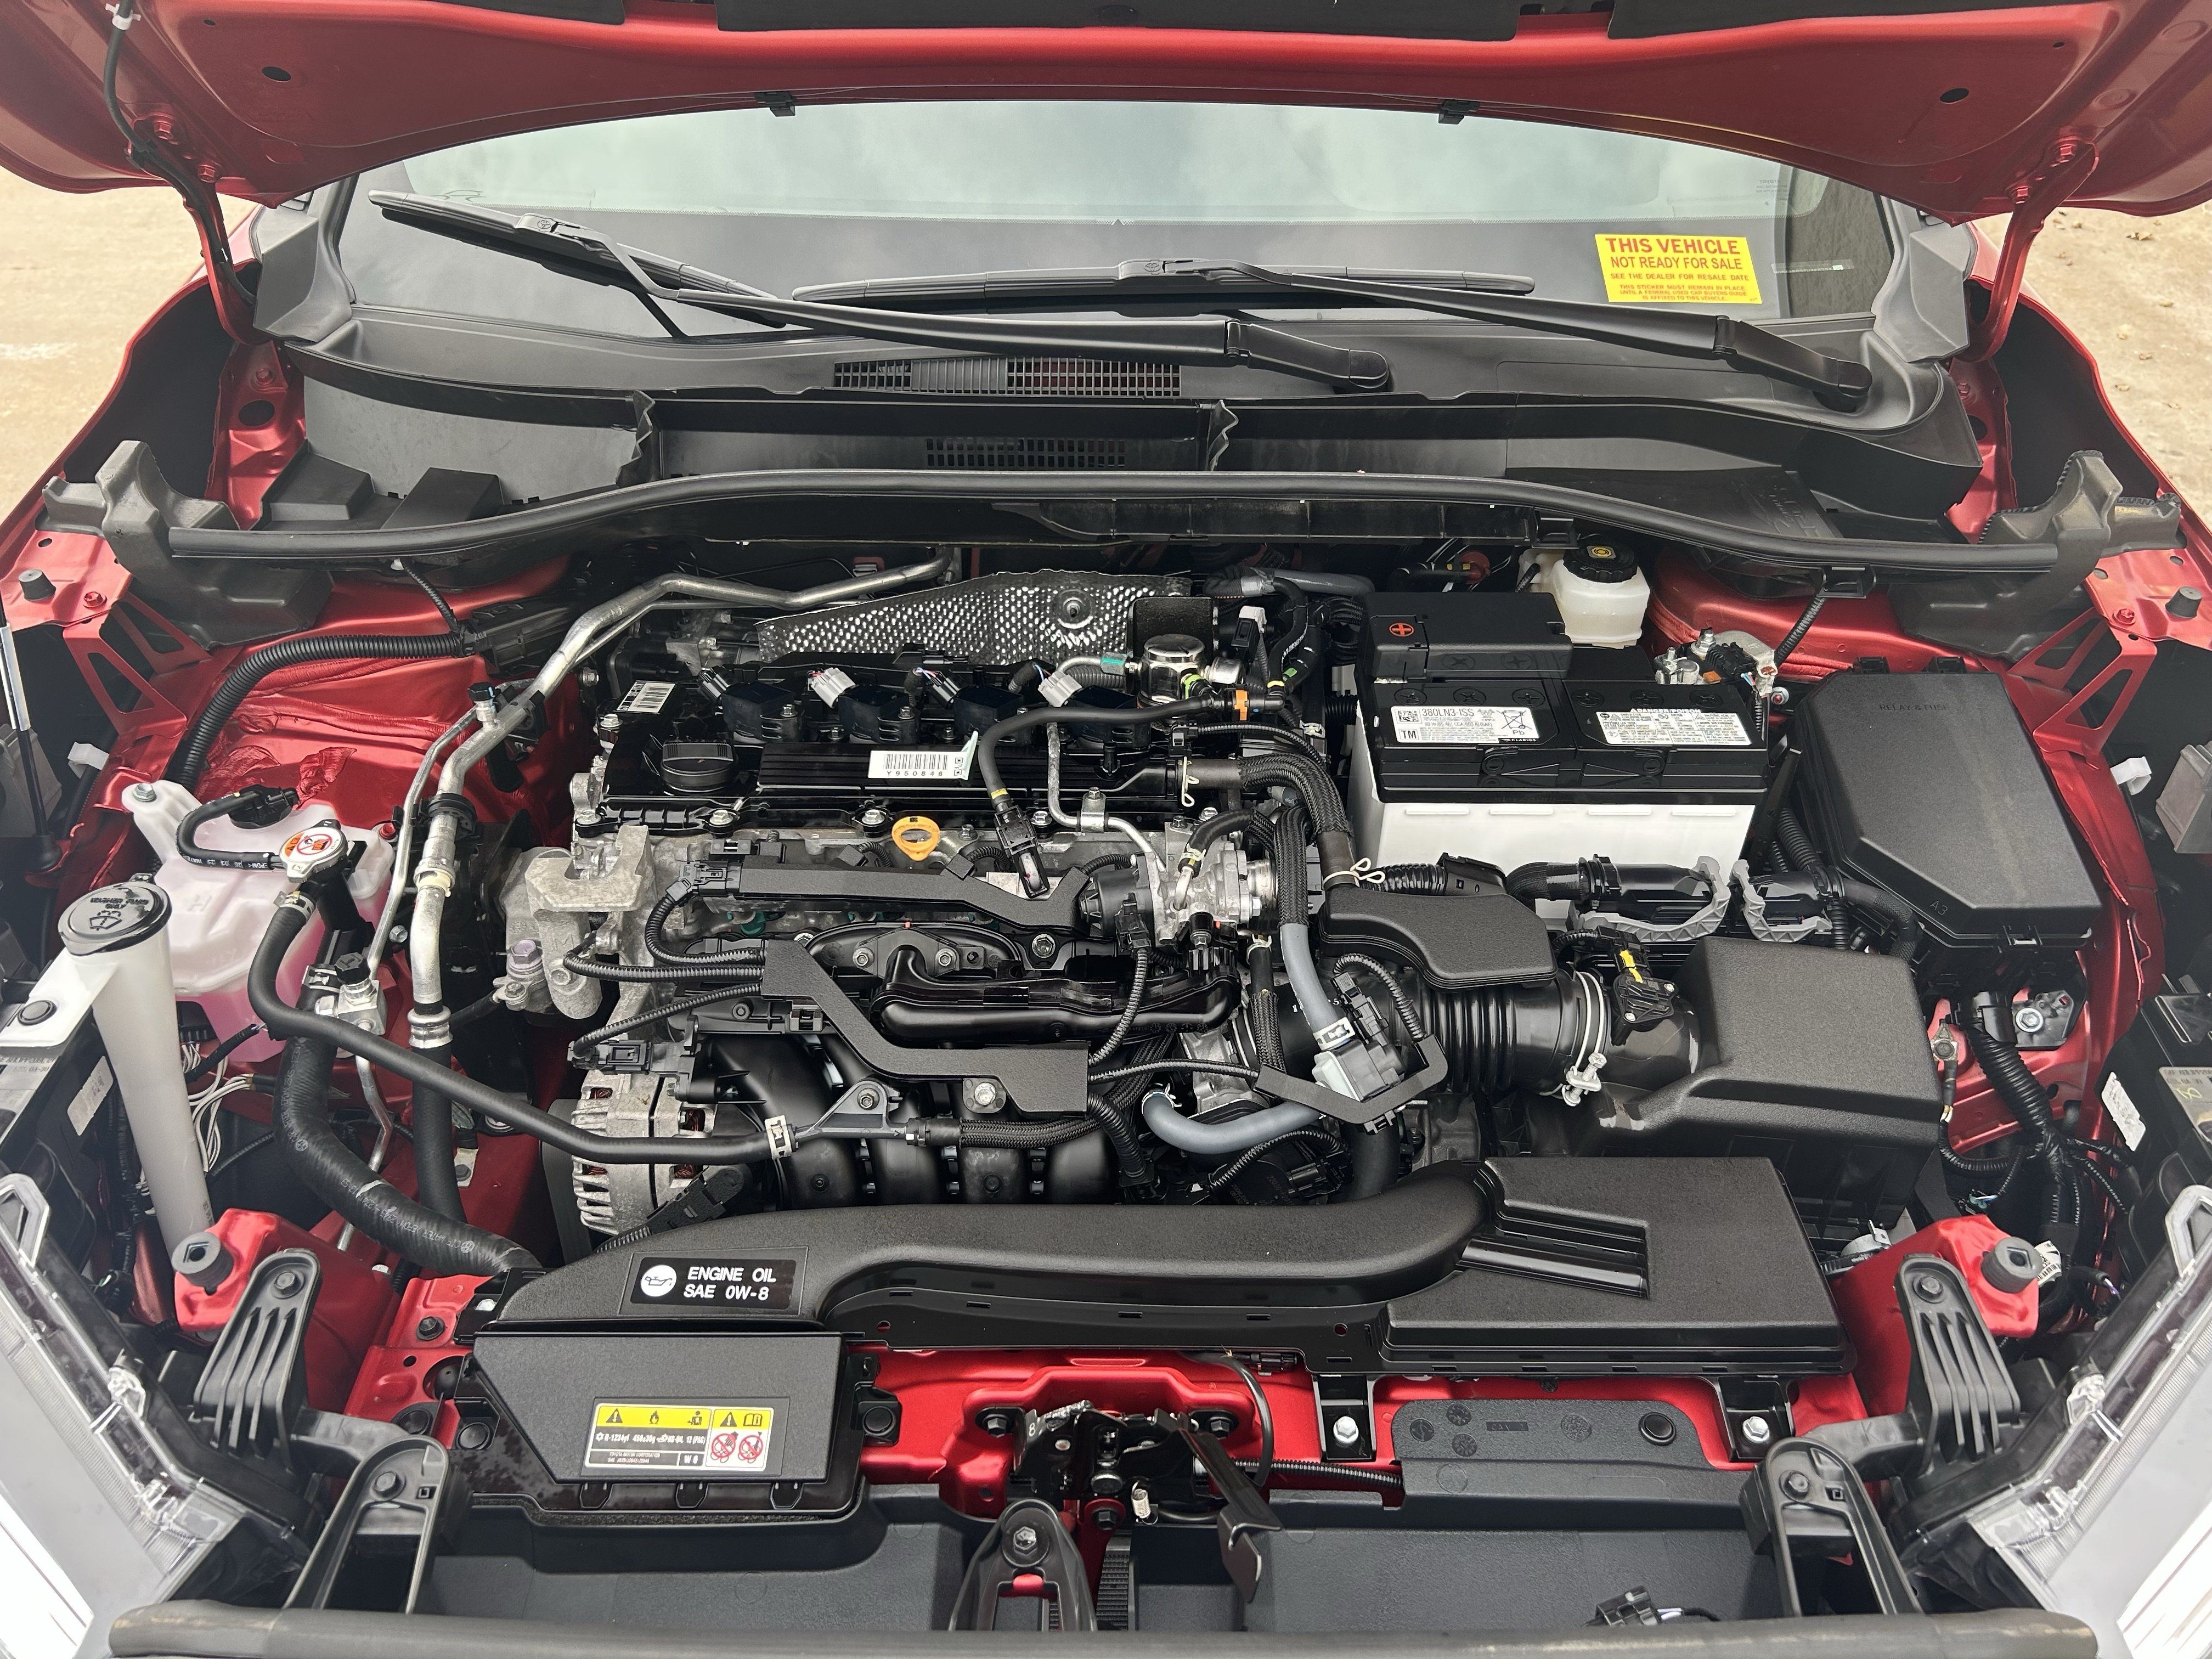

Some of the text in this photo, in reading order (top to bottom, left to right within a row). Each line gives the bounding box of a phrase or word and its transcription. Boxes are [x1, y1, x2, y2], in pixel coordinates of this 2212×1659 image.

[1605, 238, 1741, 255] THIS VEHICLE
[1611, 256, 1743, 269] NOT READY FOR SALE
[1421, 708, 1475, 716] 380LN3-ISS
[1401, 730, 1417, 739] TM
[1929, 900, 1948, 916] A3
[687, 1266, 777, 1283] ENGINE OIL
[683, 1284, 770, 1301] SAE 0W-8
[1029, 1422, 1036, 1437] 8
